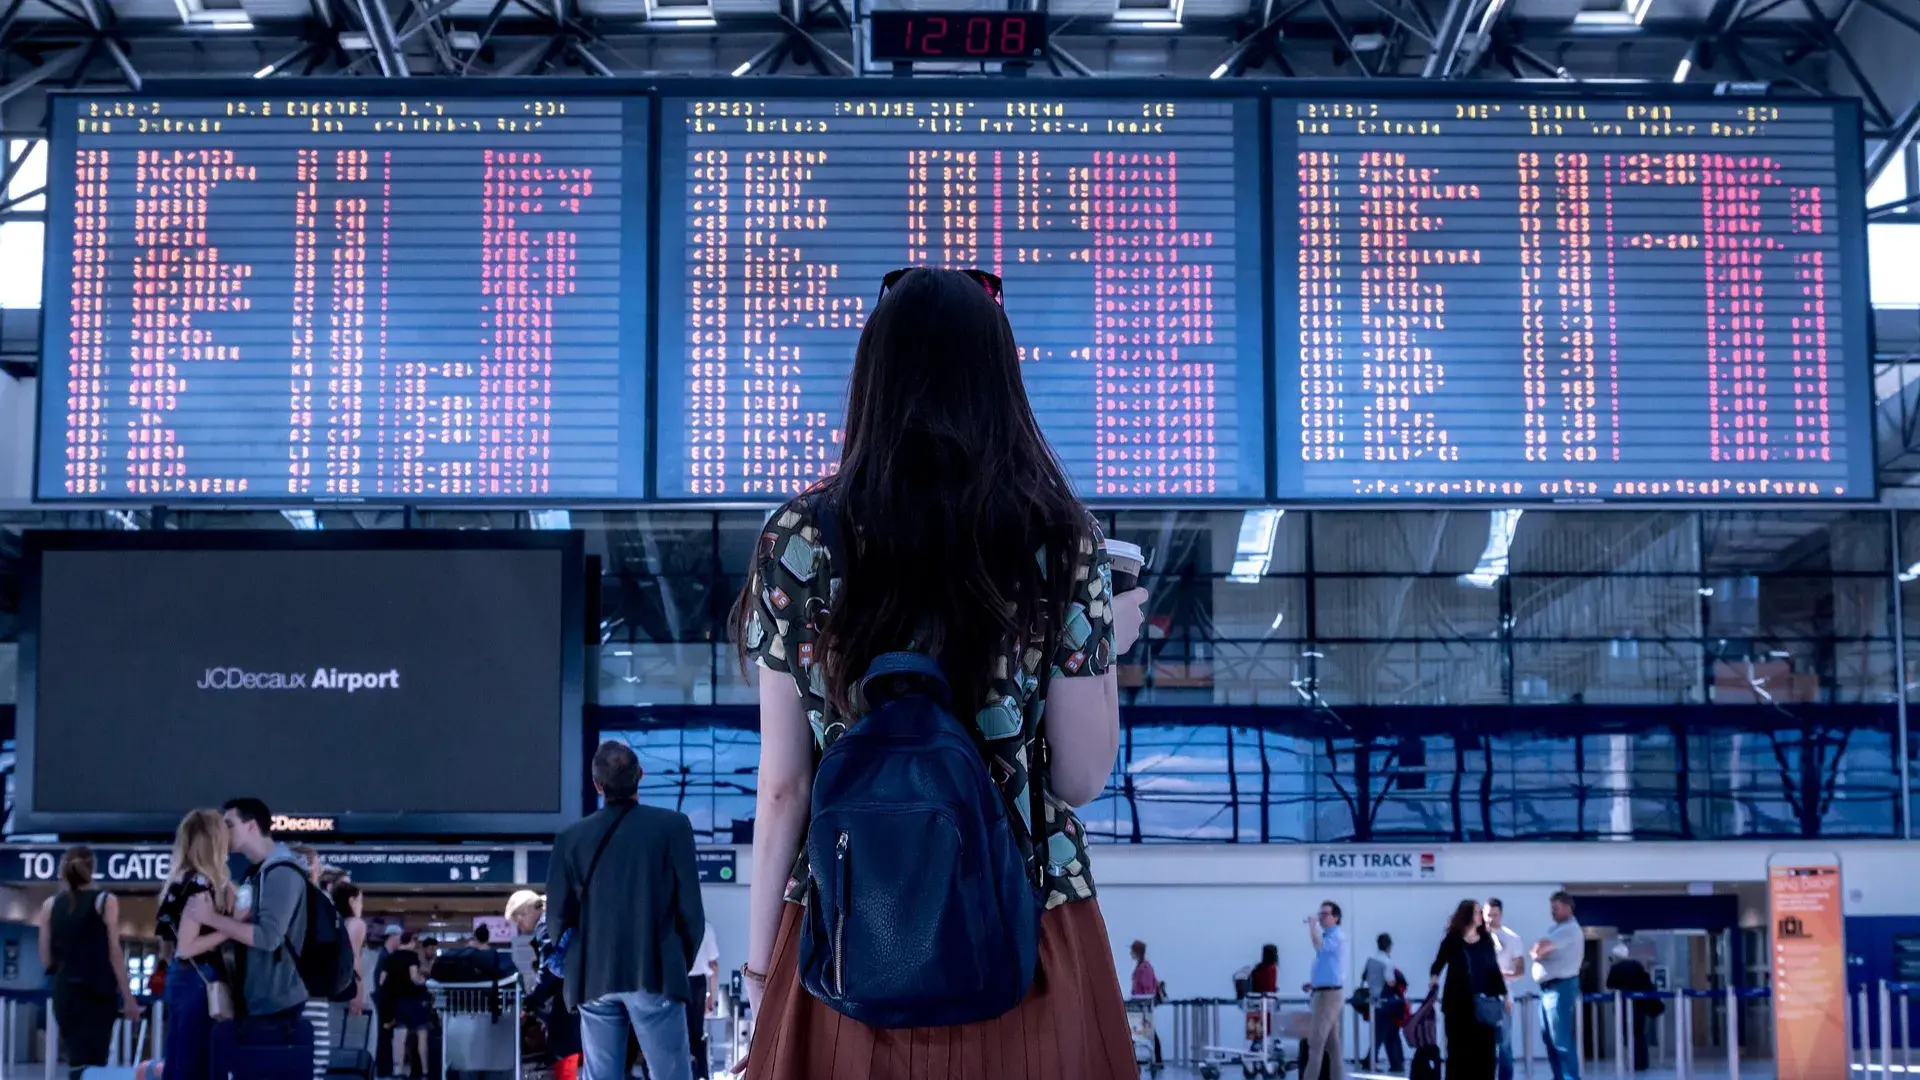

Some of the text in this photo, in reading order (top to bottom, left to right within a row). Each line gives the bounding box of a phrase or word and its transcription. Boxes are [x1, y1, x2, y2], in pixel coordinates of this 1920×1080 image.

[197, 667, 400, 692] JCDecaux Airport
[19, 853, 55, 879] TO
[328, 854, 348, 863] YOUR
[349, 854, 387, 864] PASSPORT
[388, 854, 404, 864] AND
[405, 854, 443, 864] BOARDING
[445, 854, 463, 864] PASS
[464, 854, 490, 864] READY
[1319, 853, 1412, 868] FAST TRACK
